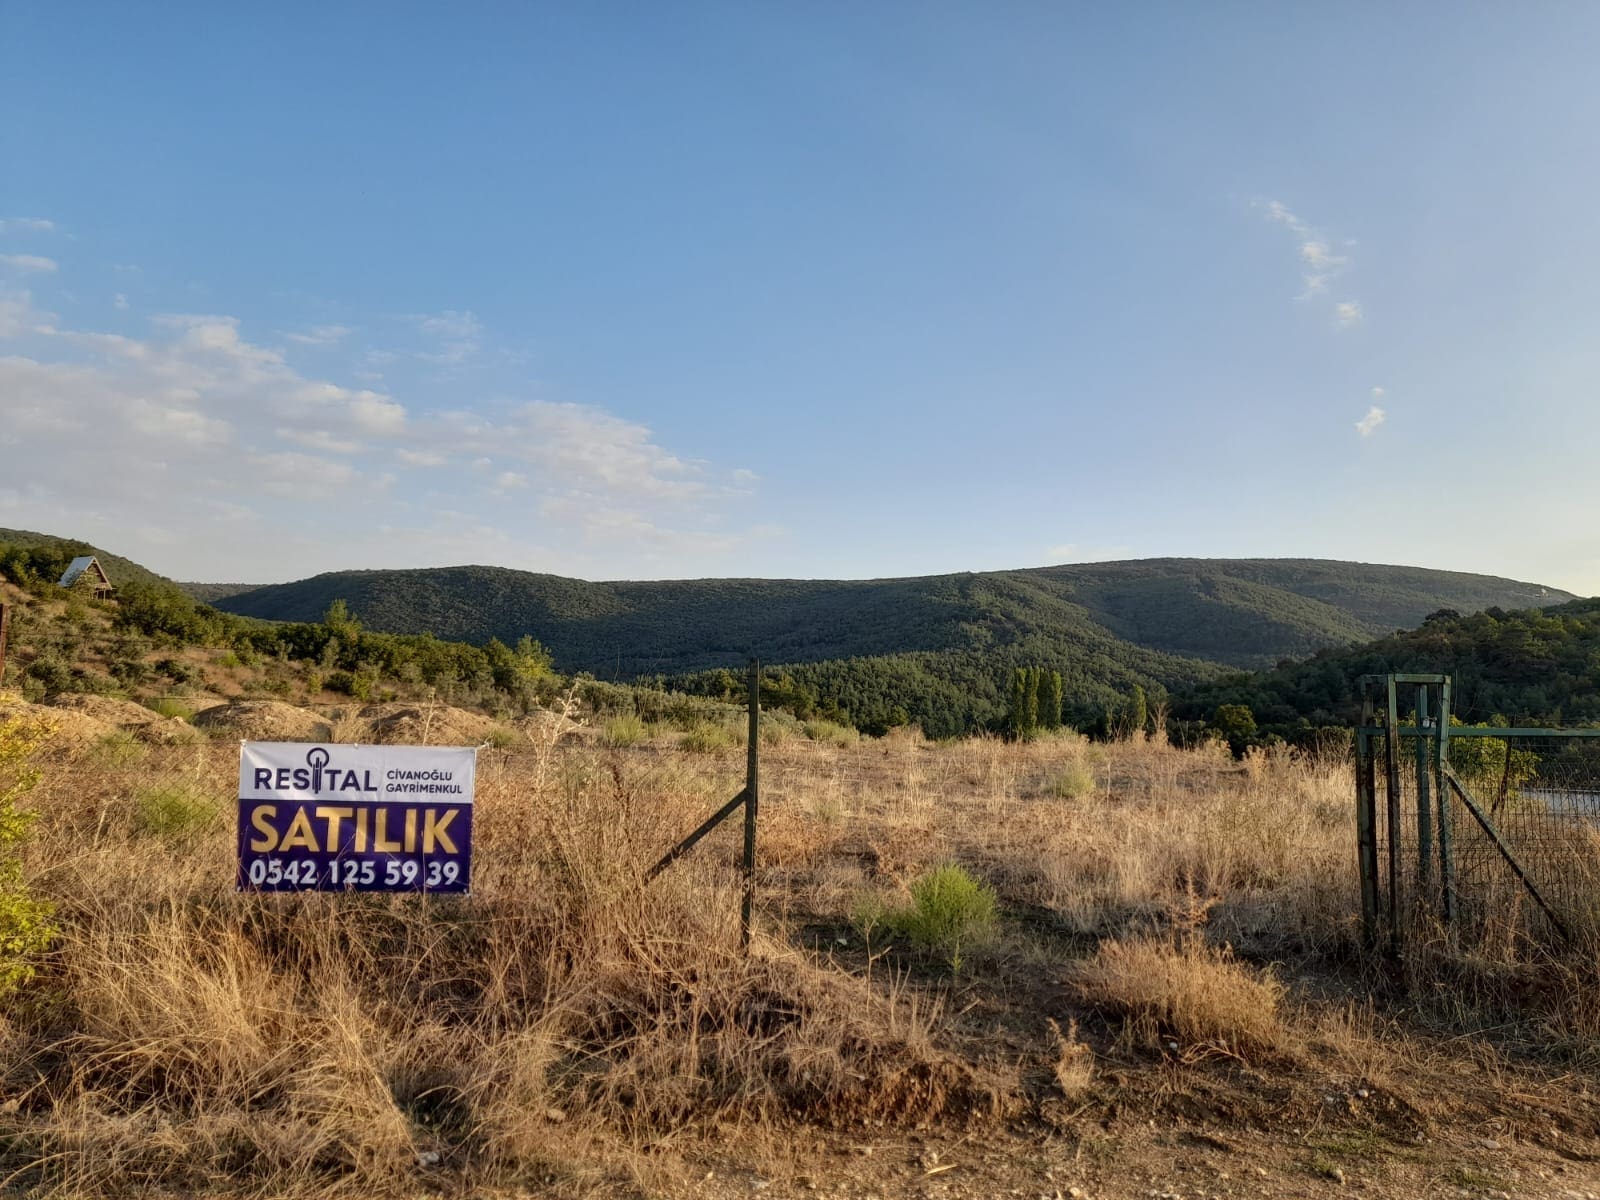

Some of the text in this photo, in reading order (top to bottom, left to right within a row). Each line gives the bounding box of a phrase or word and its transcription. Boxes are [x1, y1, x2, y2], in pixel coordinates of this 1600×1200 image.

[386, 768, 453, 781] CİVANOĞLU
[385, 781, 463, 794] GAYRİMENKUL
[250, 804, 460, 855] SATILIK
[249, 859, 460, 887] 0542 125 59 39
